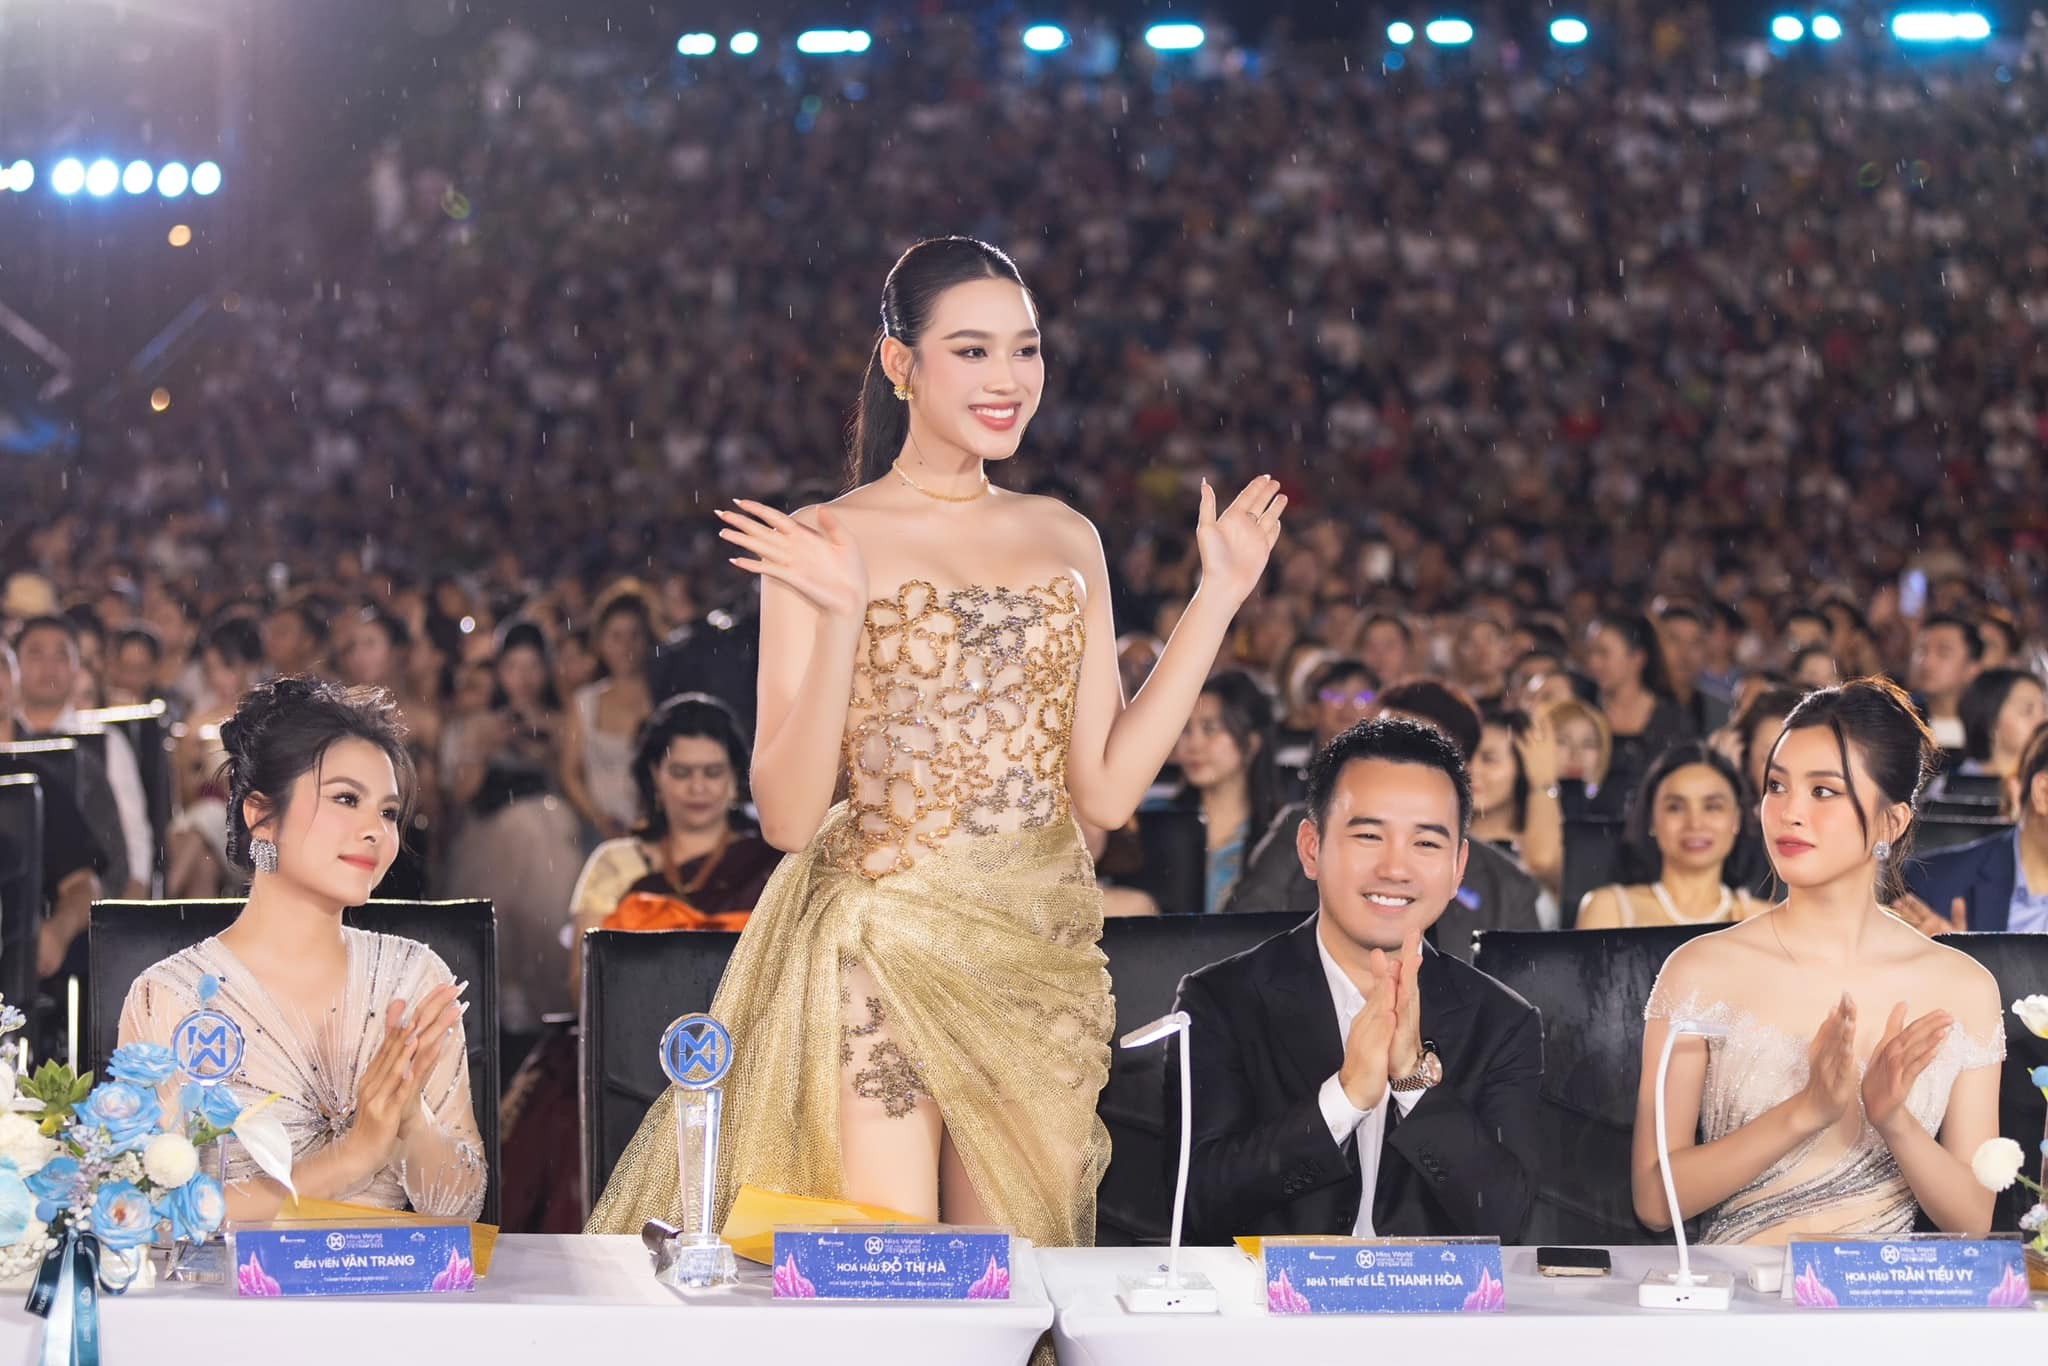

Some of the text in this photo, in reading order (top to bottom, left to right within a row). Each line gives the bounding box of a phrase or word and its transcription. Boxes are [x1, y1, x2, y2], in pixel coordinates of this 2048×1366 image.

[370, 1255, 415, 1267] TRANG
[1306, 1275, 1327, 1287] NHÀ
[1388, 1273, 1432, 1286] THANH
[1845, 1272, 1866, 1282] HOA
[1956, 1269, 1973, 1281] VY
